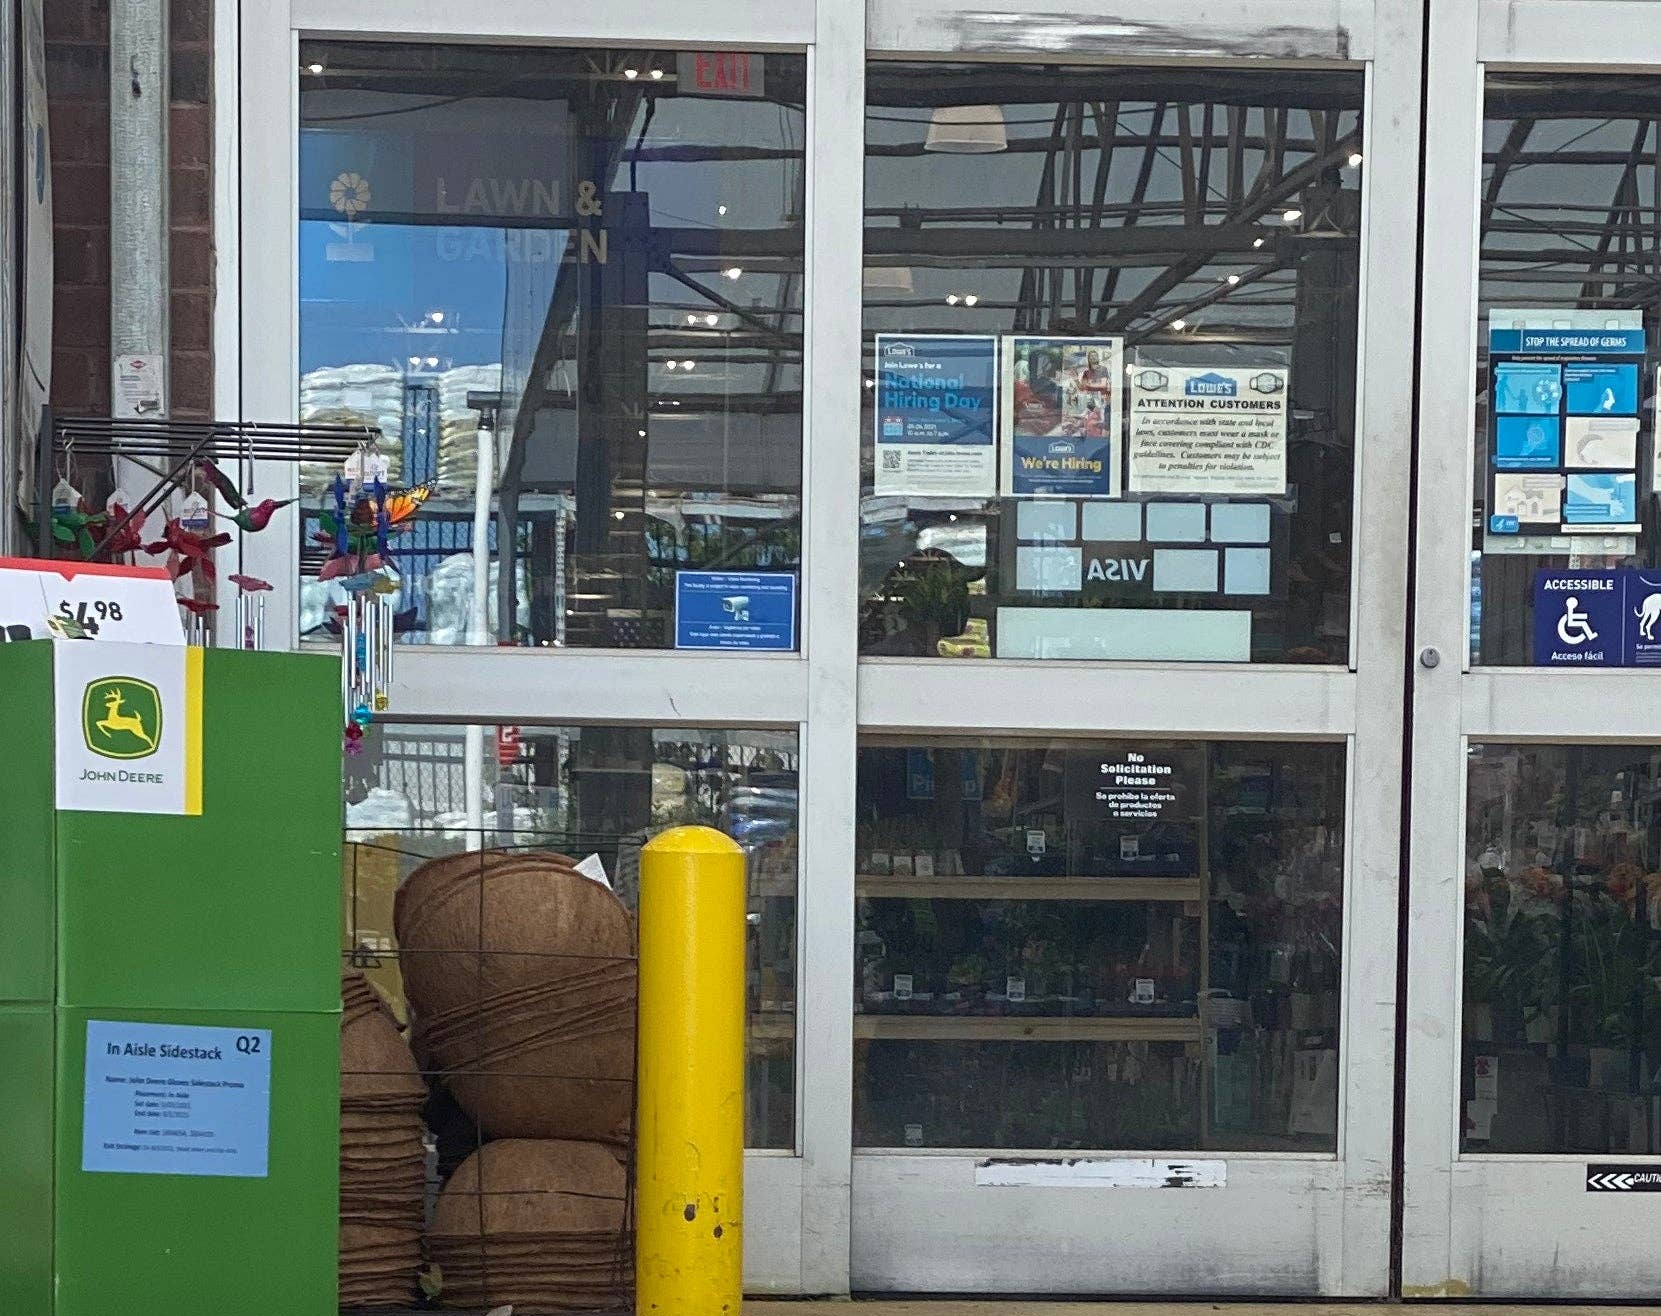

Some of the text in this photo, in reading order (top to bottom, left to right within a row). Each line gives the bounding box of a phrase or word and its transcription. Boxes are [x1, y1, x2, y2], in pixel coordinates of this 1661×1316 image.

[695, 52, 750, 91] EXIT
[436, 177, 602, 217] LAWN &
[436, 227, 608, 265] GARDEN
[1525, 336, 1627, 348] STOP THE SPREAD OF GERMS
[884, 372, 964, 390] National
[1190, 381, 1232, 394] LOWE'S
[884, 391, 980, 412] Hiring Day
[1137, 399, 1281, 409] ATTENTION CUSTOMERS
[1200, 418, 1216, 426] with
[1248, 430, 1268, 438] mask
[1181, 451, 1221, 459] Customers
[1021, 456, 1102, 472] We're Hiring
[1204, 463, 1217, 471] for
[1543, 579, 1614, 590] ACCESSIBLE
[1551, 651, 1604, 661] Acceso fácil
[1127, 752, 1144, 762] No
[1100, 763, 1171, 774] Solicitation
[79, 769, 164, 784] JOHN DEERE
[1115, 775, 1156, 785] Please
[1095, 791, 1107, 800] Se
[1149, 793, 1175, 801] oferta
[1120, 801, 1162, 809] productos
[236, 1036, 261, 1055] Q2
[107, 1043, 222, 1060] In Aisle Sidestack
